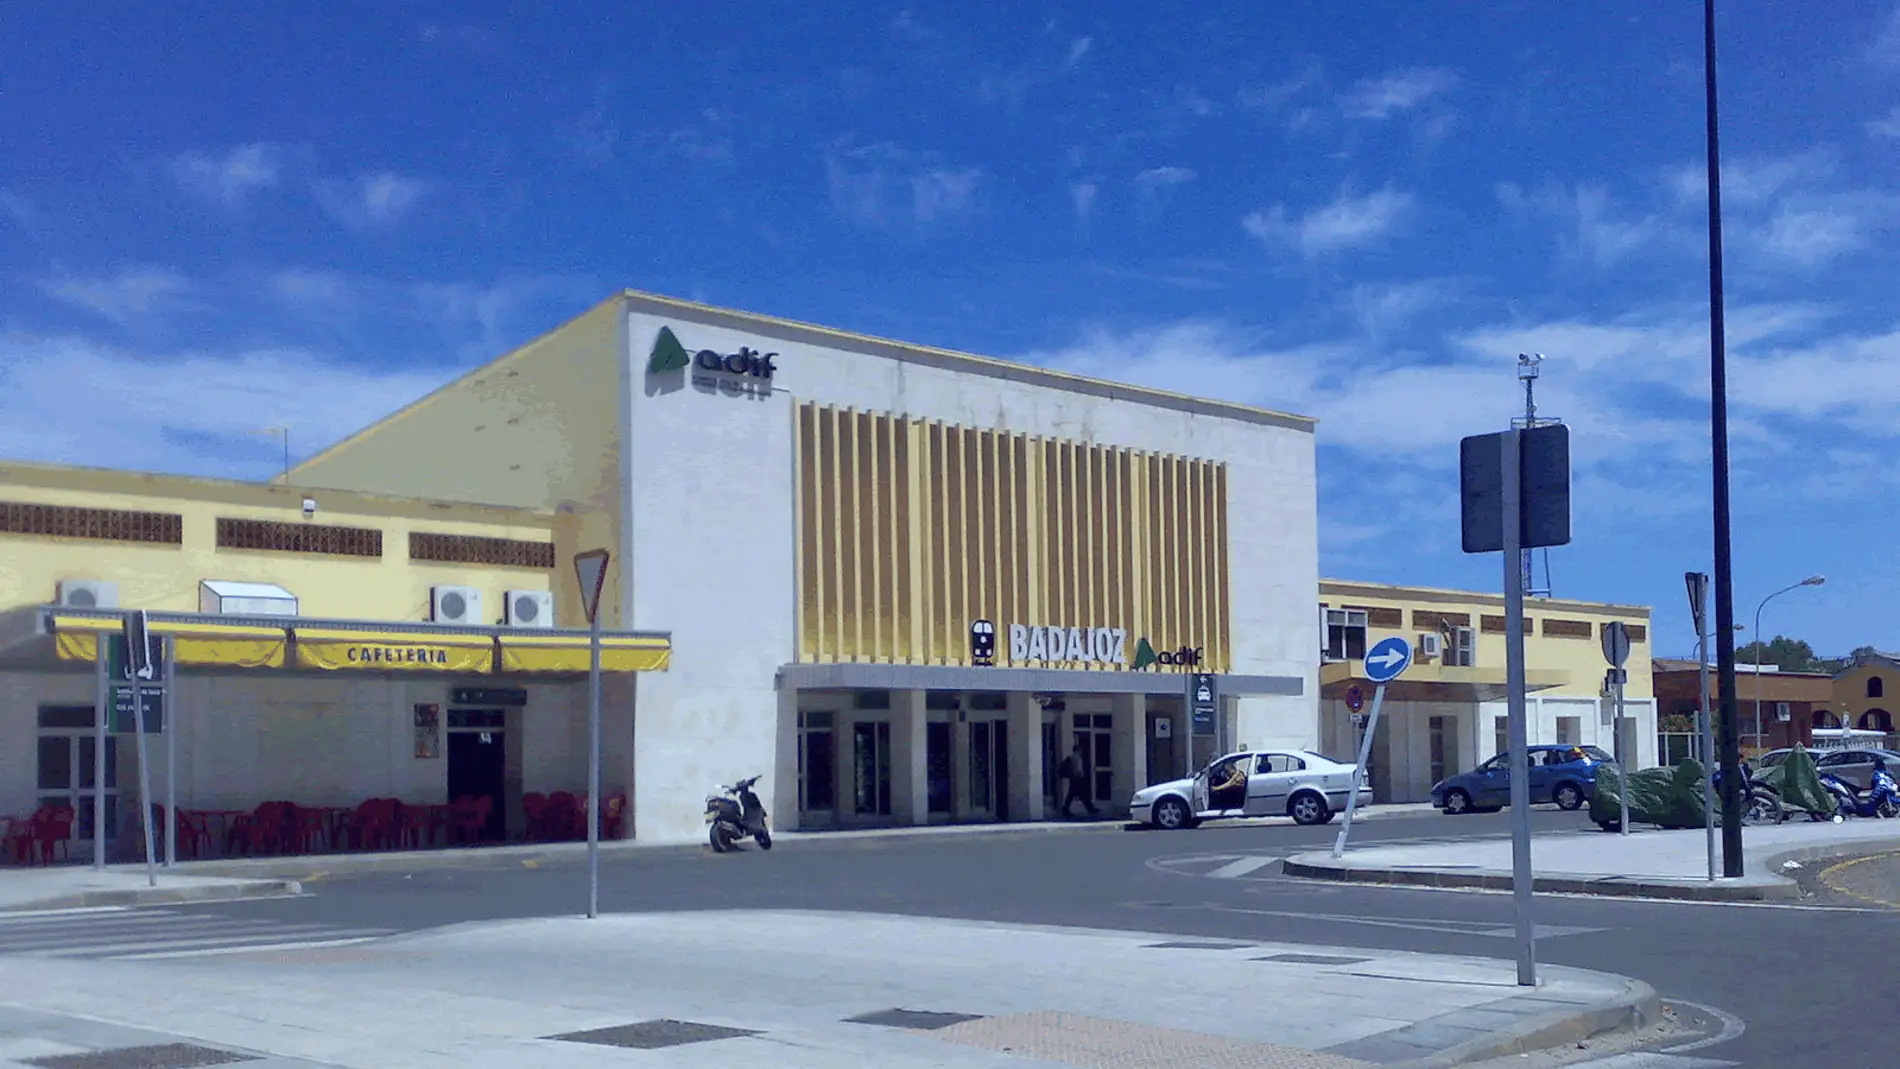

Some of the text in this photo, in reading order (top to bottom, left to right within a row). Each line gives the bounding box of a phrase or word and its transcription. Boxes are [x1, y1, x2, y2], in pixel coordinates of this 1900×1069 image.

[695, 346, 779, 379] adif
[347, 647, 447, 663] CAFETERIA
[1009, 623, 1126, 664] BADAJOZ
[1158, 645, 1203, 666] adif
